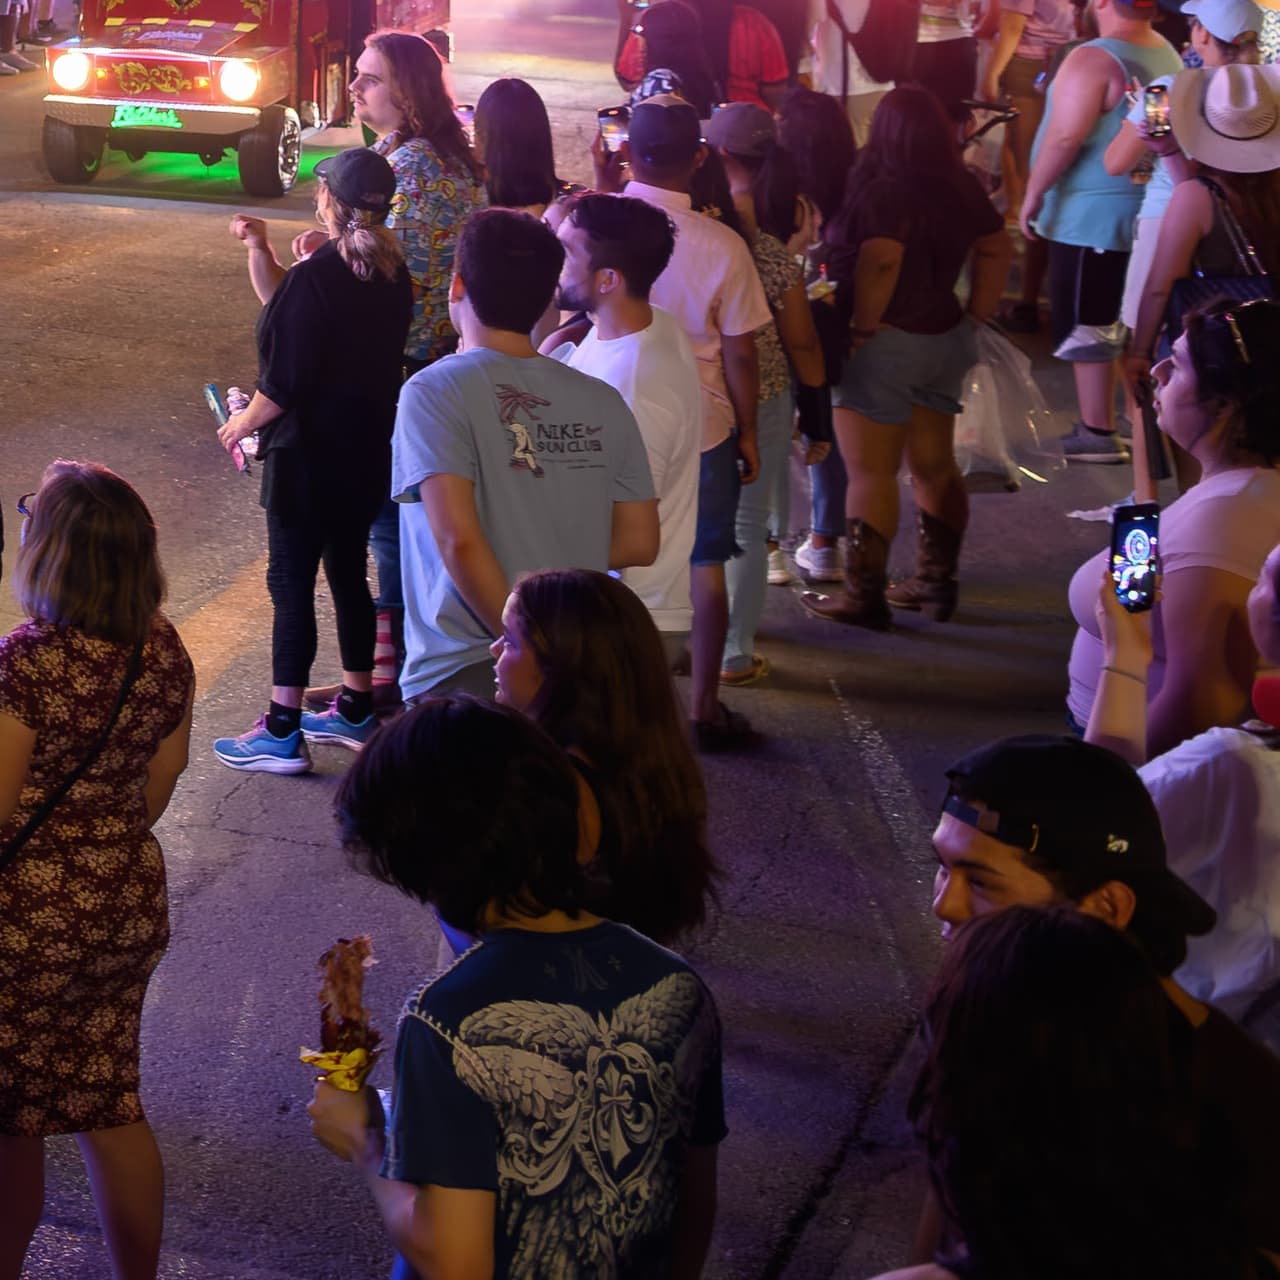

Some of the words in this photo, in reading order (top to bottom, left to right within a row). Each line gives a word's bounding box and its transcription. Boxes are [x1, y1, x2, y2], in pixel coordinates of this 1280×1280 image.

[536, 423, 585, 440] NIKE
[536, 440, 565, 453] SUN
[566, 439, 602, 453] CLUB
